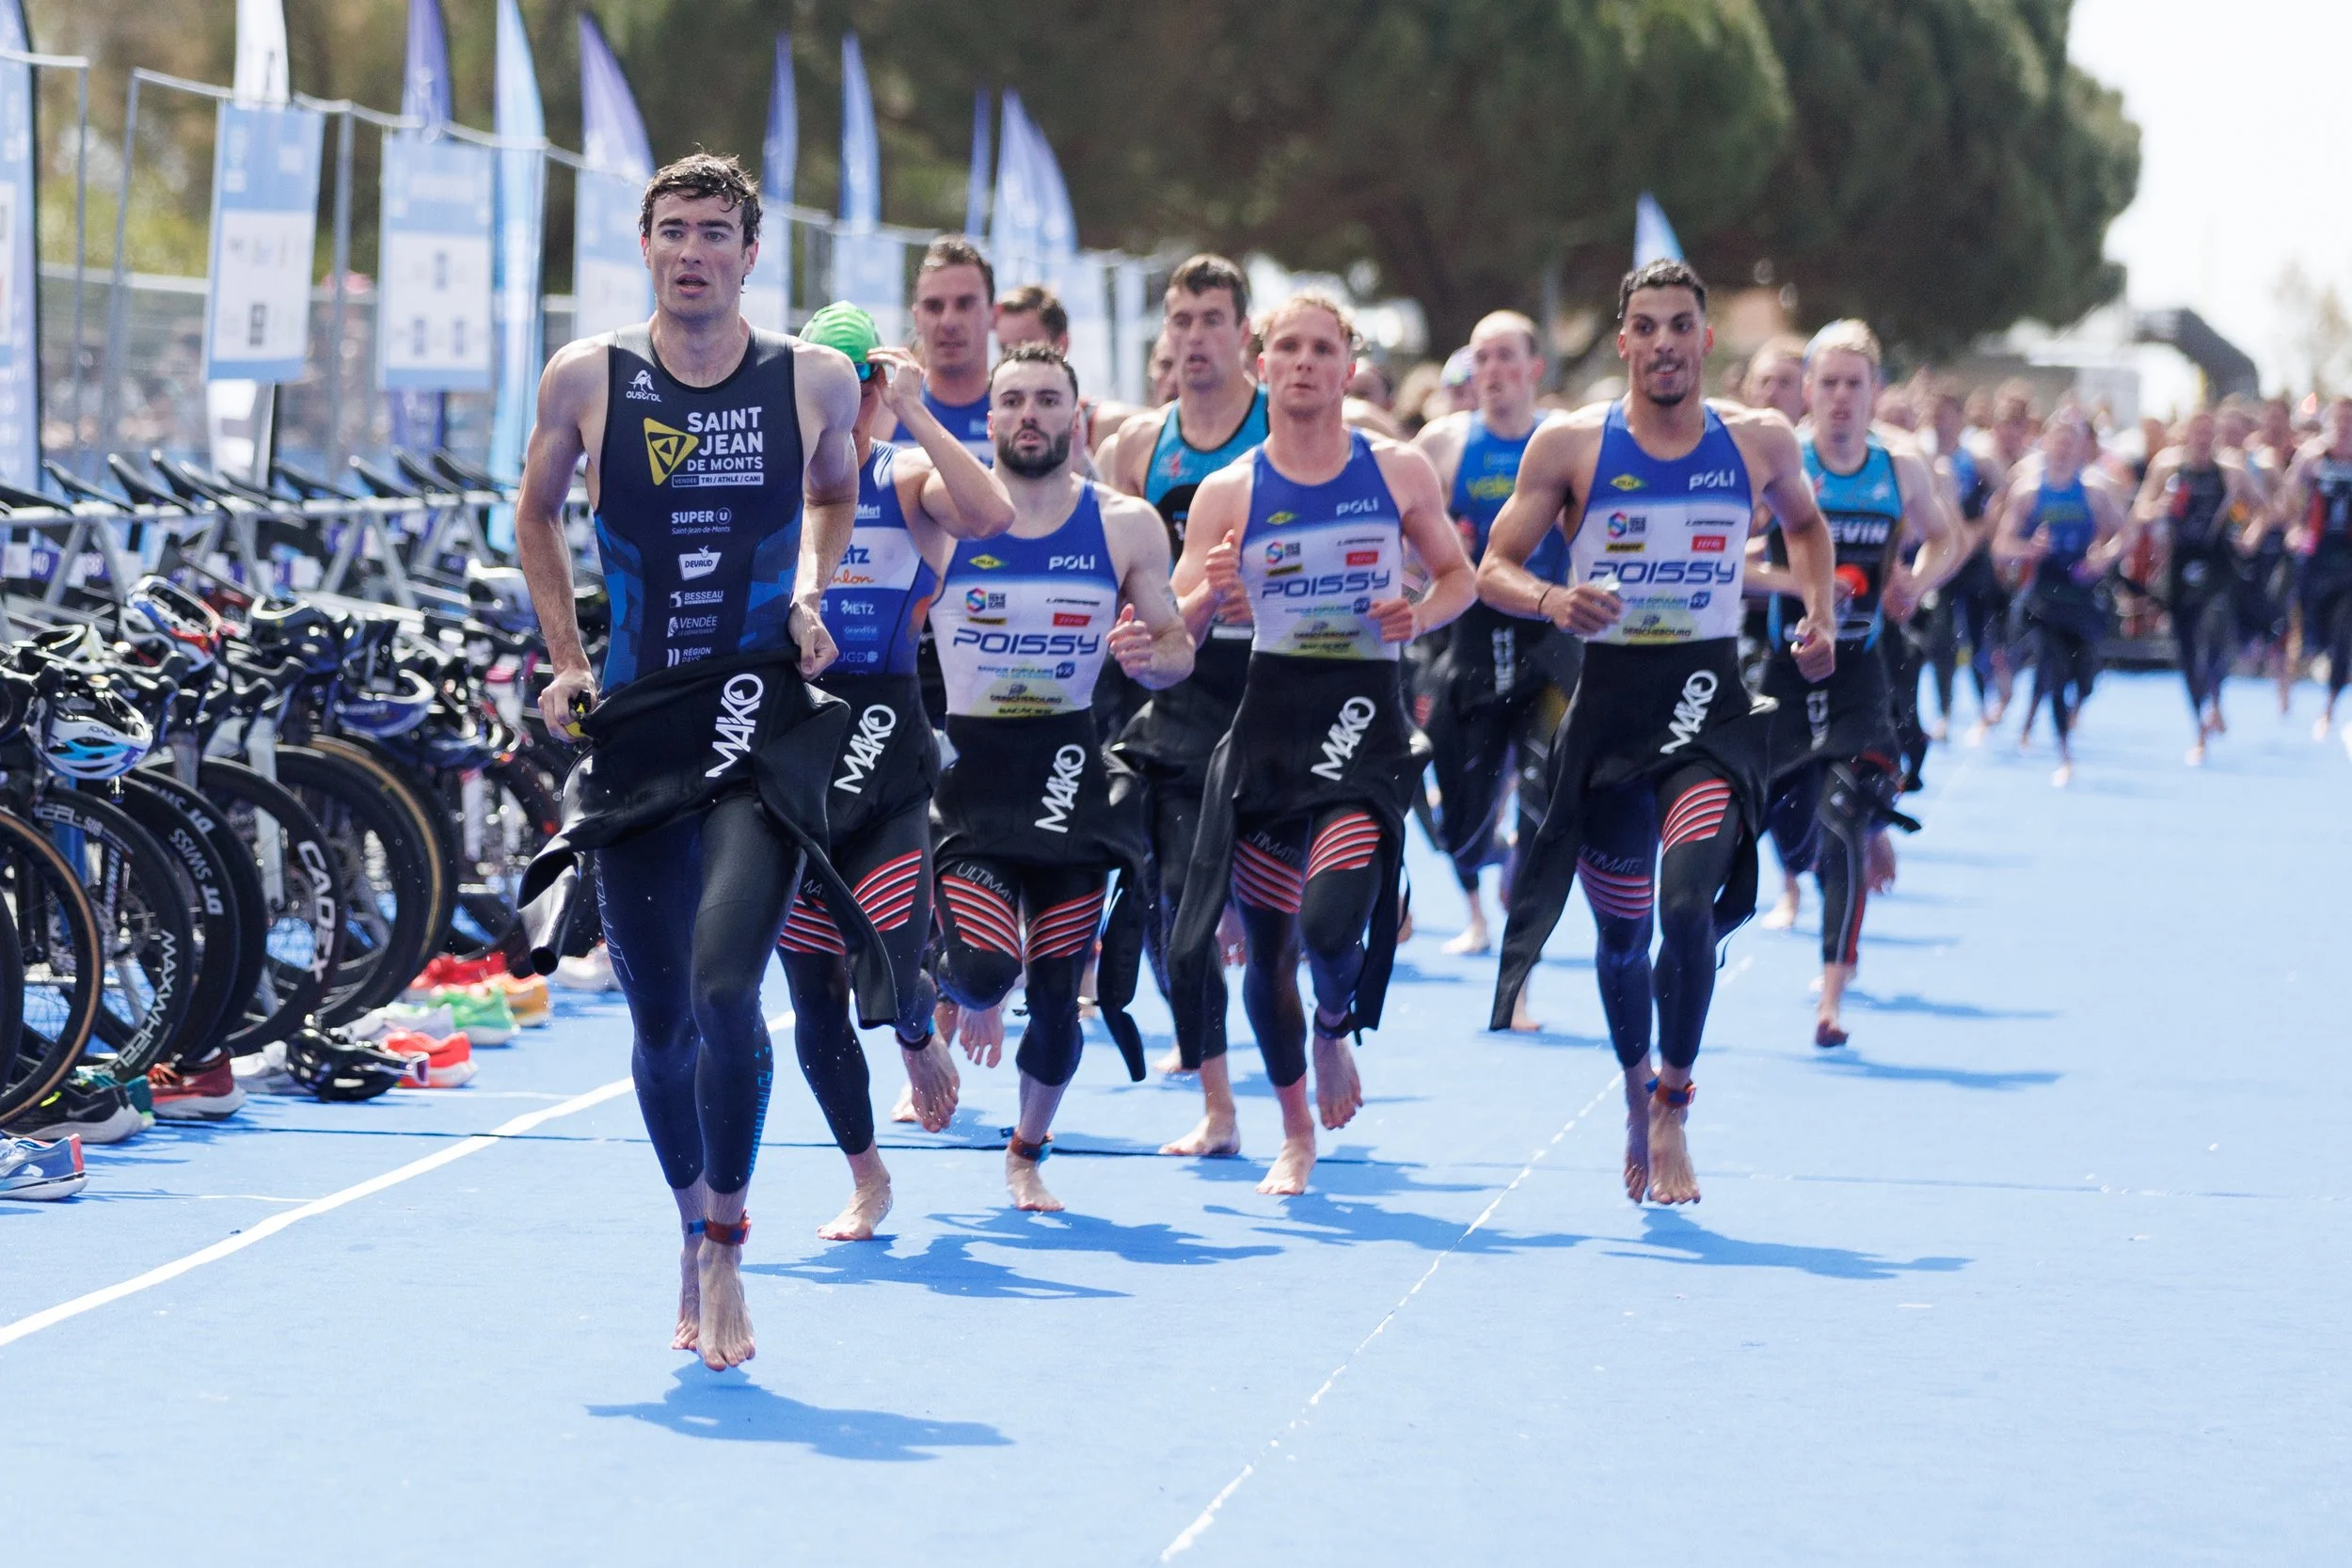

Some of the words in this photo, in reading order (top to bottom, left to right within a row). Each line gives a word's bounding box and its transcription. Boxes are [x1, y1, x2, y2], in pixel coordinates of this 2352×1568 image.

[687, 406, 762, 433] SAINT
[698, 431, 764, 456] JEAN
[687, 459, 706, 471] DE
[710, 456, 763, 471] MONTS
[744, 474, 761, 483] CANI
[1689, 469, 1736, 491] POLI
[671, 511, 714, 524] SUPER
[1335, 497, 1379, 516] POLI
[671, 526, 731, 535] Saint-Jean-de-Monts
[684, 560, 713, 568] DEVAUD
[1048, 554, 1096, 570] POLI
[1588, 561, 1736, 584] POISSY
[684, 591, 723, 601] BESSEAU
[1262, 569, 1391, 599] POISSY
[679, 613, 718, 629] VENDÉE
[683, 646, 712, 657] RÉGION
[953, 627, 1101, 656] POISSY
[1659, 669, 1719, 753] MAKO
[705, 673, 764, 778] MAKO
[834, 704, 897, 794] MAKO
[1310, 696, 1376, 782] MAKO
[1035, 743, 1086, 833] MAKO
[167, 827, 214, 881] SWISS
[200, 886, 224, 916] DT
[296, 840, 337, 984] CADEX
